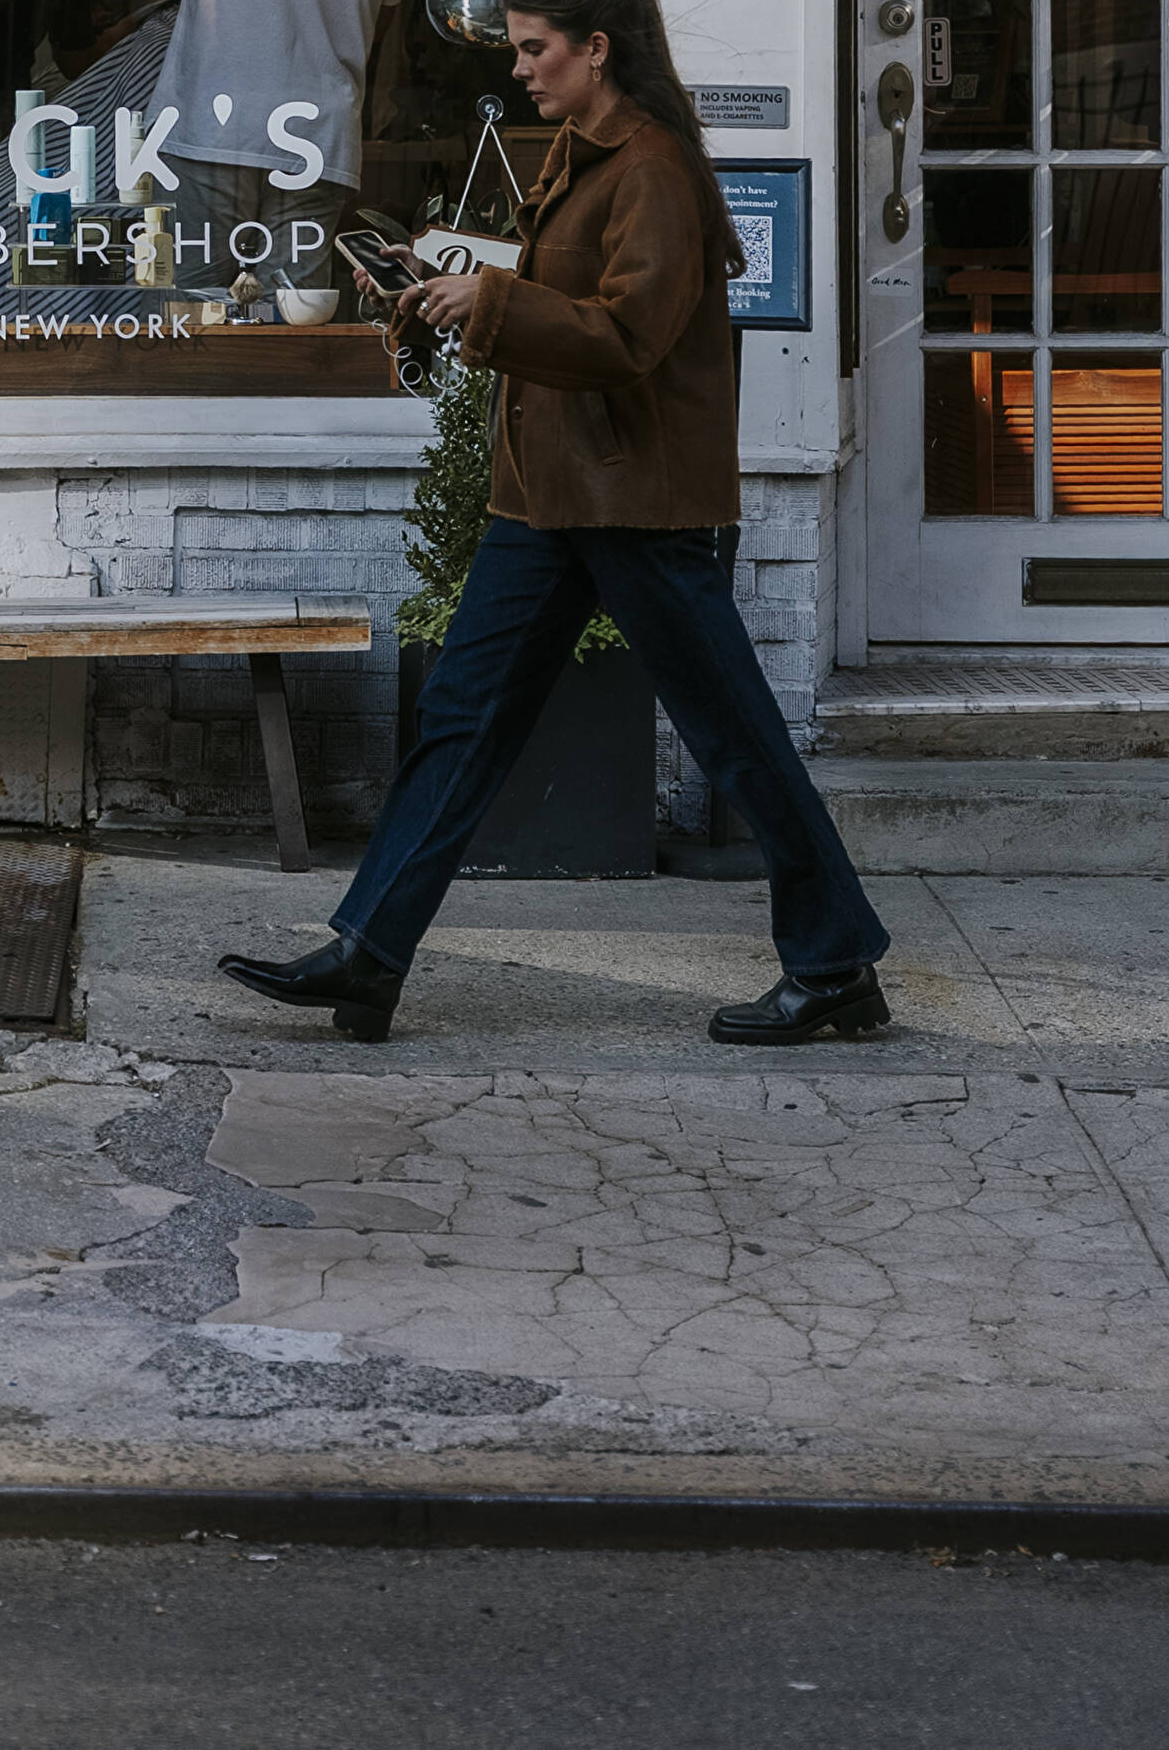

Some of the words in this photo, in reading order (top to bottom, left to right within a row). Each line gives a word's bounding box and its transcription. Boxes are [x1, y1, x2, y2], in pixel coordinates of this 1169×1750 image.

[931, 23, 943, 80] PULL
[701, 92, 720, 102] NO
[722, 92, 783, 104] SMOKING
[722, 185, 746, 194] don't
[748, 185, 768, 194] have
[726, 199, 778, 209] pointment?
[736, 288, 771, 299] Booking
[89, 313, 191, 340] YORK
